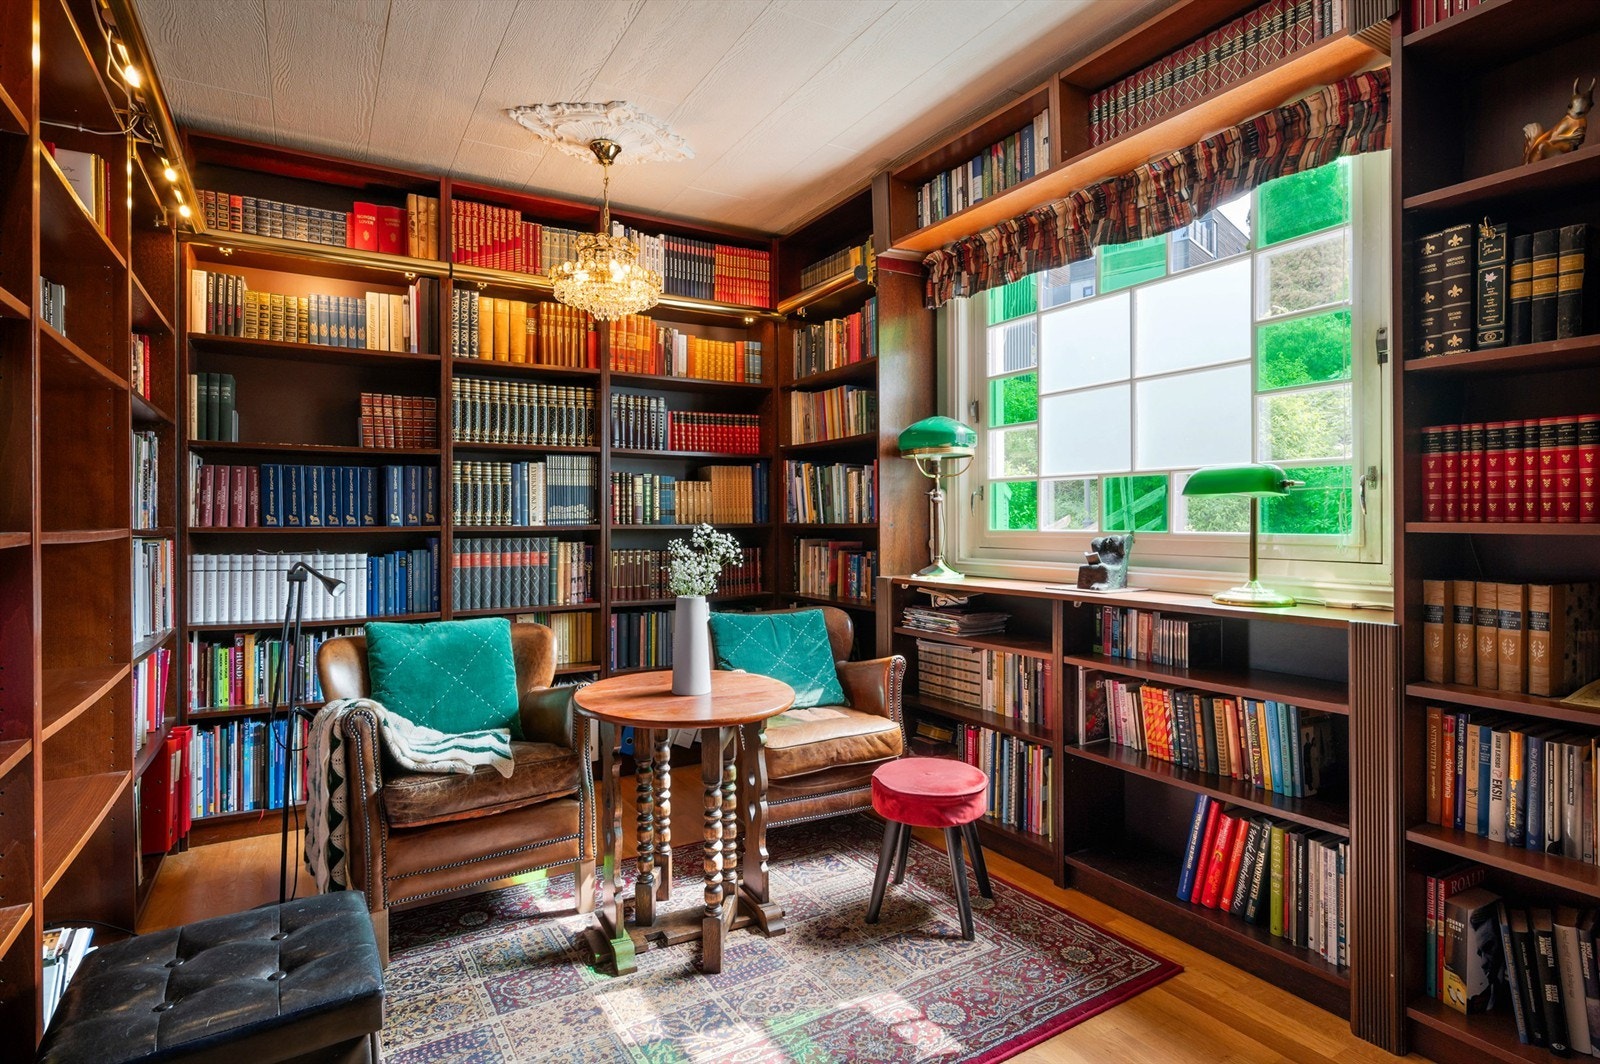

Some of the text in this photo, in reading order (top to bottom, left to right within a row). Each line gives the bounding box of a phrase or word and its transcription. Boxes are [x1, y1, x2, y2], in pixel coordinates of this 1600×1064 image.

[452, 295, 460, 323] VERDEN
[461, 296, 469, 324] VERDEN
[470, 297, 479, 324] VERDEN
[452, 328, 460, 345] KRIG
[461, 329, 469, 346] KRIG
[470, 330, 479, 346] KRIG
[1444, 758, 1452, 798] storbritannia
[1492, 778, 1502, 801] EKSIL
[1252, 852, 1264, 900] RELIGIONER
[1274, 879, 1282, 896] BY
[1446, 918, 1465, 928] JOHNNY
[1448, 923, 1462, 933] CASH
[1580, 941, 1590, 979] STORBERGET
[1585, 942, 1593, 959] KNUT
